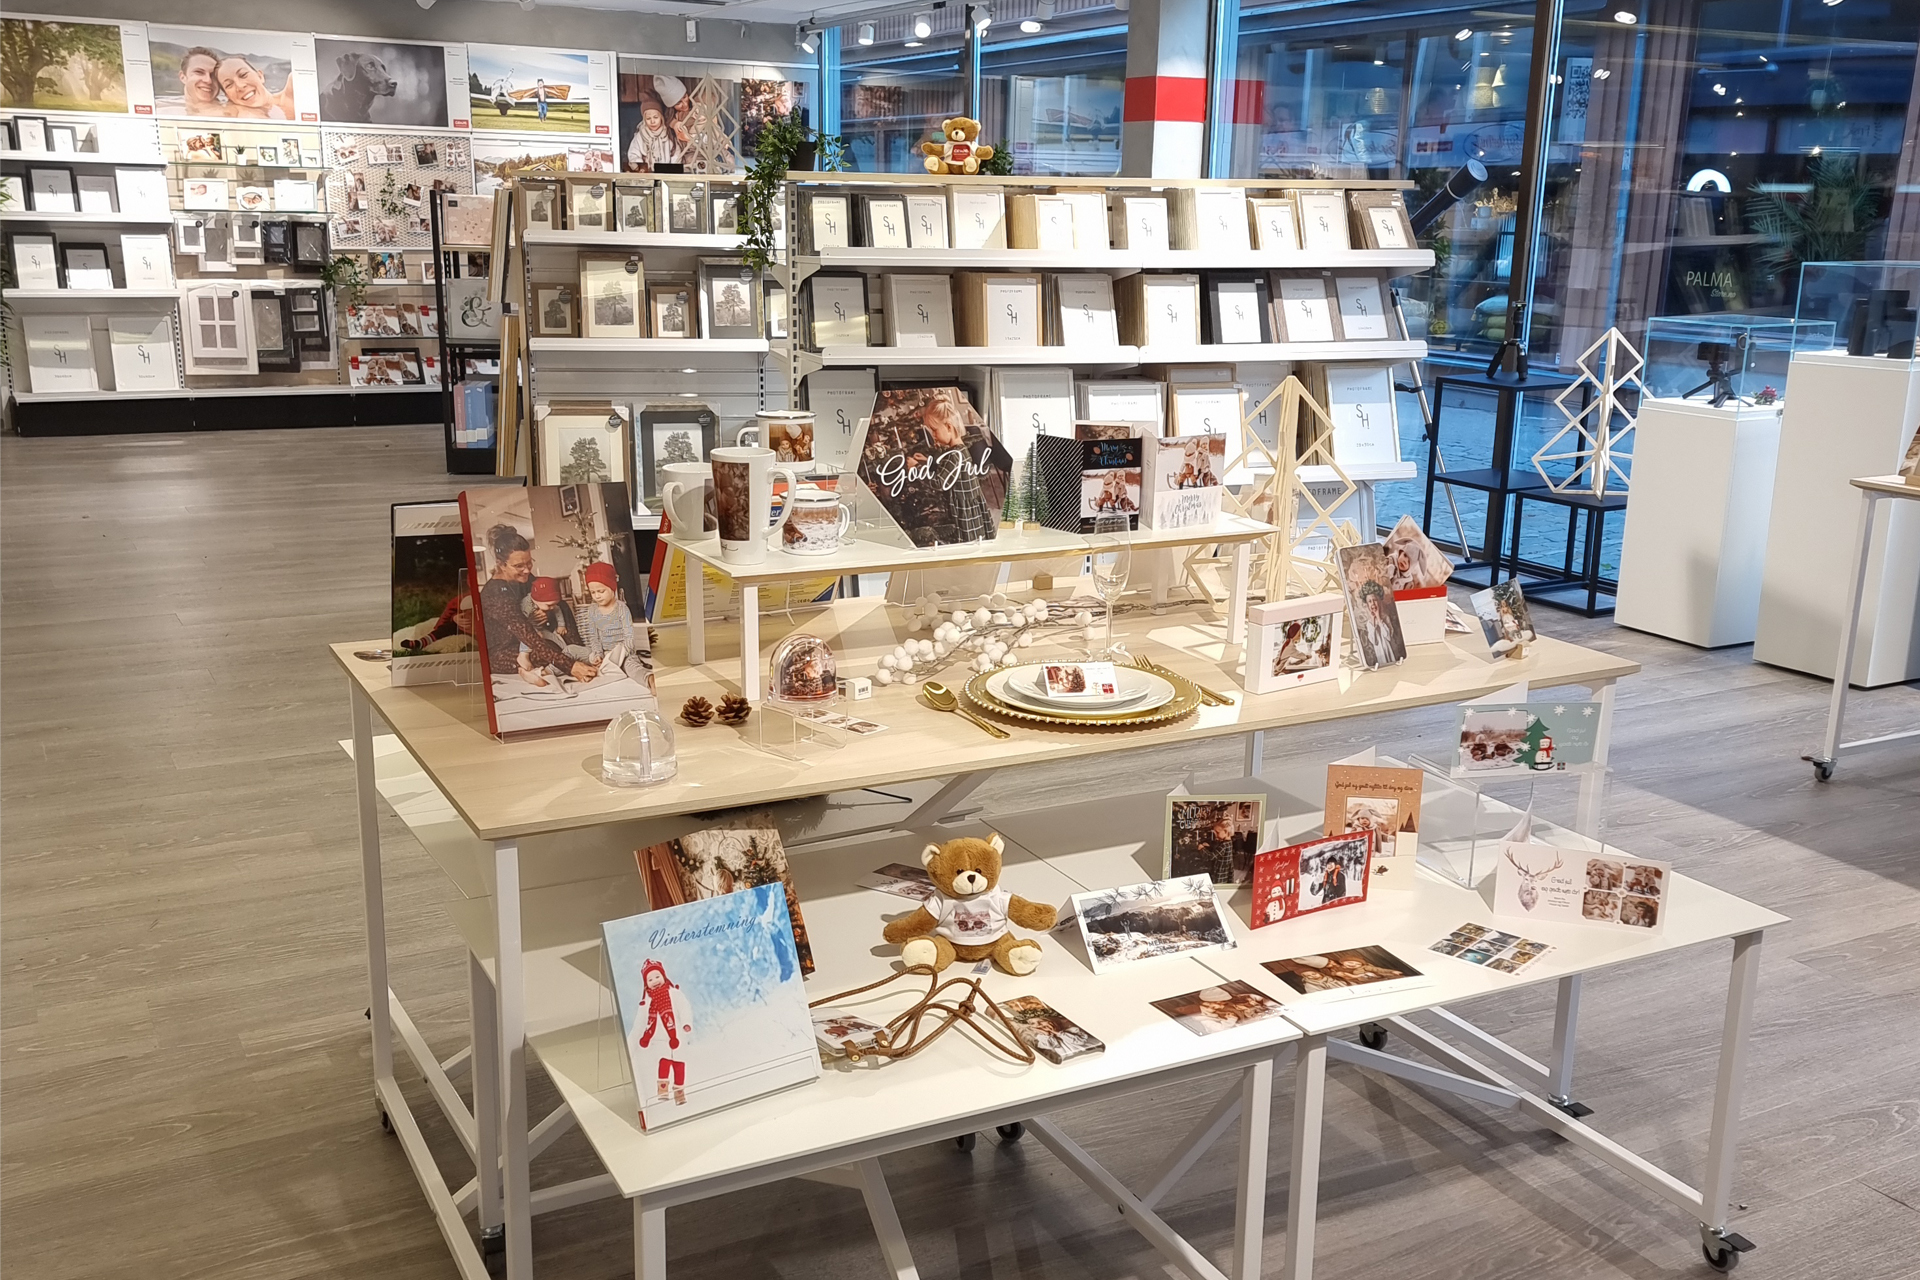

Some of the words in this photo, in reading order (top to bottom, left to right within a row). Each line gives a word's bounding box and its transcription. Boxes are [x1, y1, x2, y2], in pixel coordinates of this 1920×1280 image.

[824, 212, 837, 235] SH
[882, 215, 896, 236] SH
[921, 214, 933, 236] SH
[975, 212, 985, 230] SH
[1141, 217, 1152, 237] SH
[1271, 220, 1283, 238] SH
[1319, 216, 1329, 232] SH
[1381, 219, 1395, 237] SH
[1686, 270, 1733, 288] PALMA
[834, 301, 846, 323] SH
[917, 303, 929, 325] SH
[1006, 303, 1018, 326] SH
[1082, 303, 1094, 324] SH
[1167, 303, 1178, 323] SH
[1234, 305, 1244, 321] SH
[1301, 300, 1313, 319] SH
[1355, 298, 1368, 317] SH
[54, 344, 67, 364] SH
[137, 344, 151, 364] SH
[836, 408, 851, 436] SH
[1355, 403, 1370, 430] SH
[876, 454, 935, 498] God
[936, 447, 992, 491] Jul
[648, 915, 757, 950] Vinterstemning
